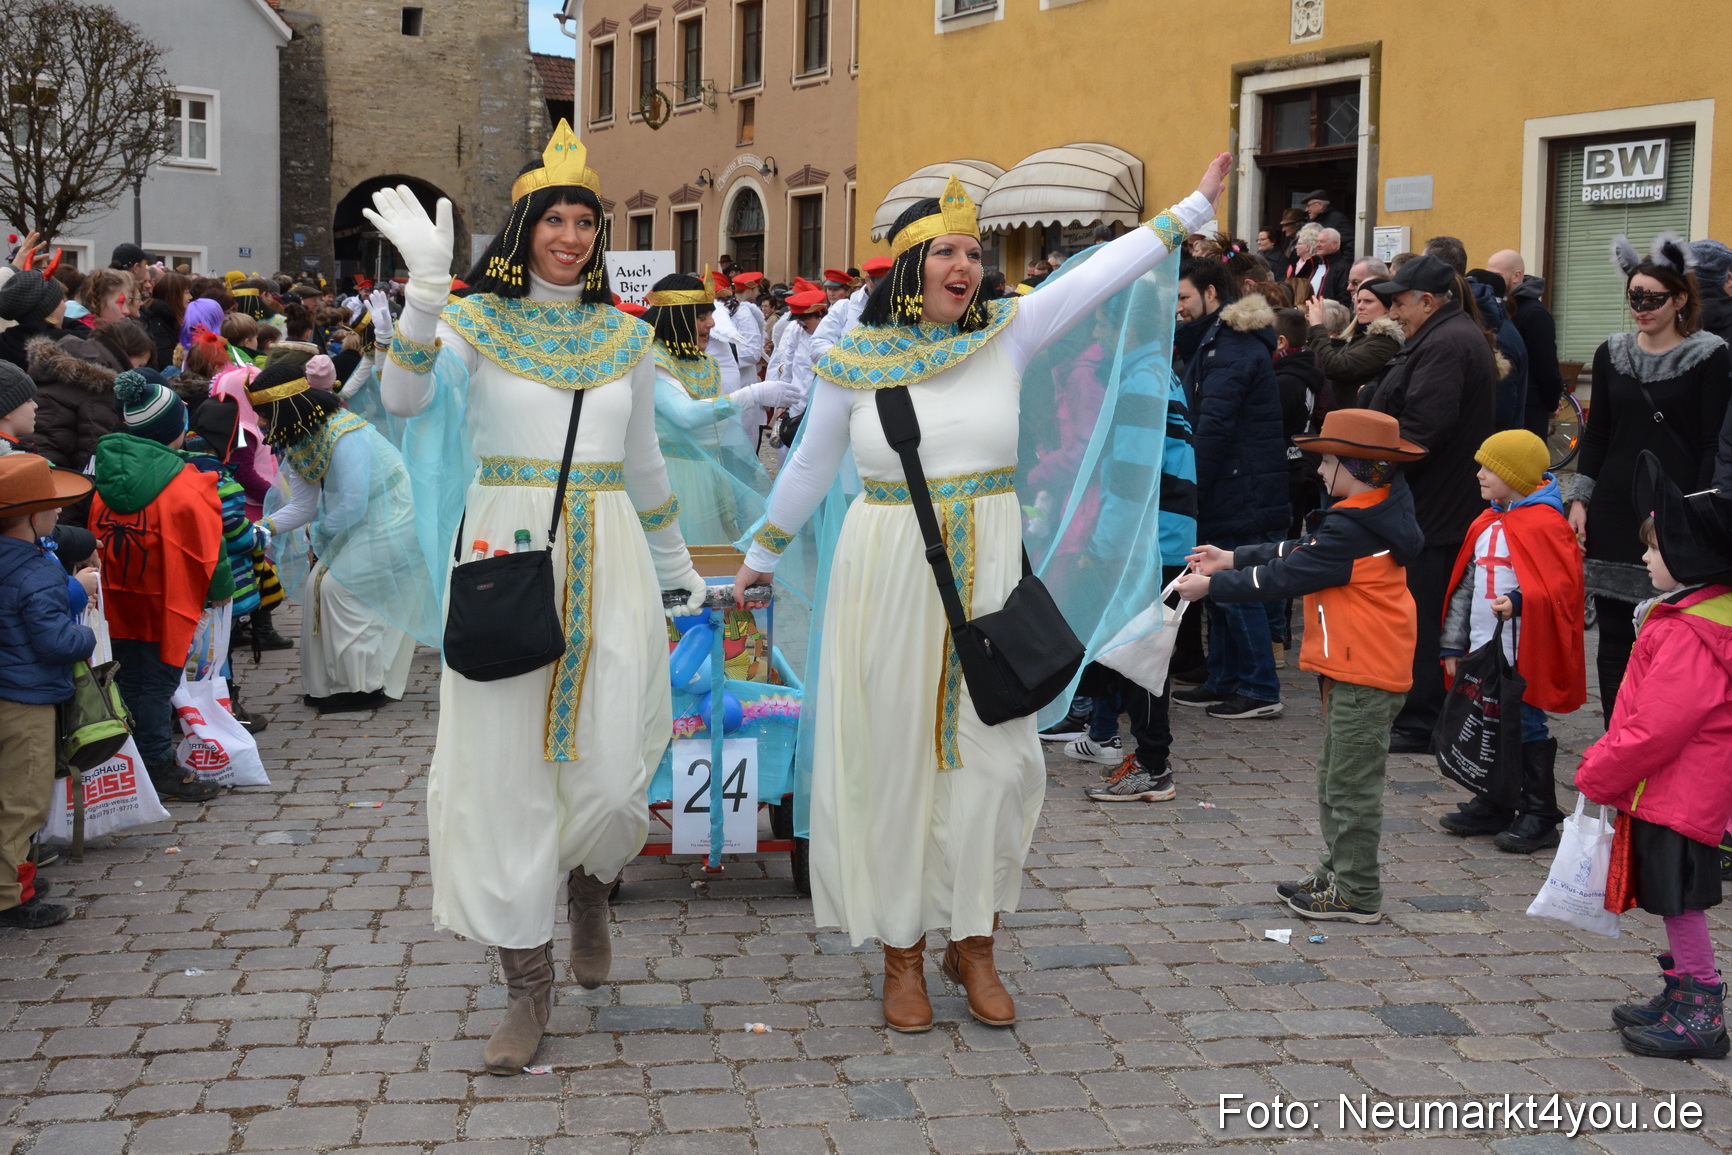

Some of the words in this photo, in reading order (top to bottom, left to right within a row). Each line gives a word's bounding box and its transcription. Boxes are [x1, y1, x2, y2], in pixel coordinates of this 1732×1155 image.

[1587, 144, 1662, 180] BW
[1582, 183, 1664, 201] Bekleidung
[615, 264, 652, 278] Auch
[619, 281, 648, 293] Bier
[683, 758, 748, 813] 24
